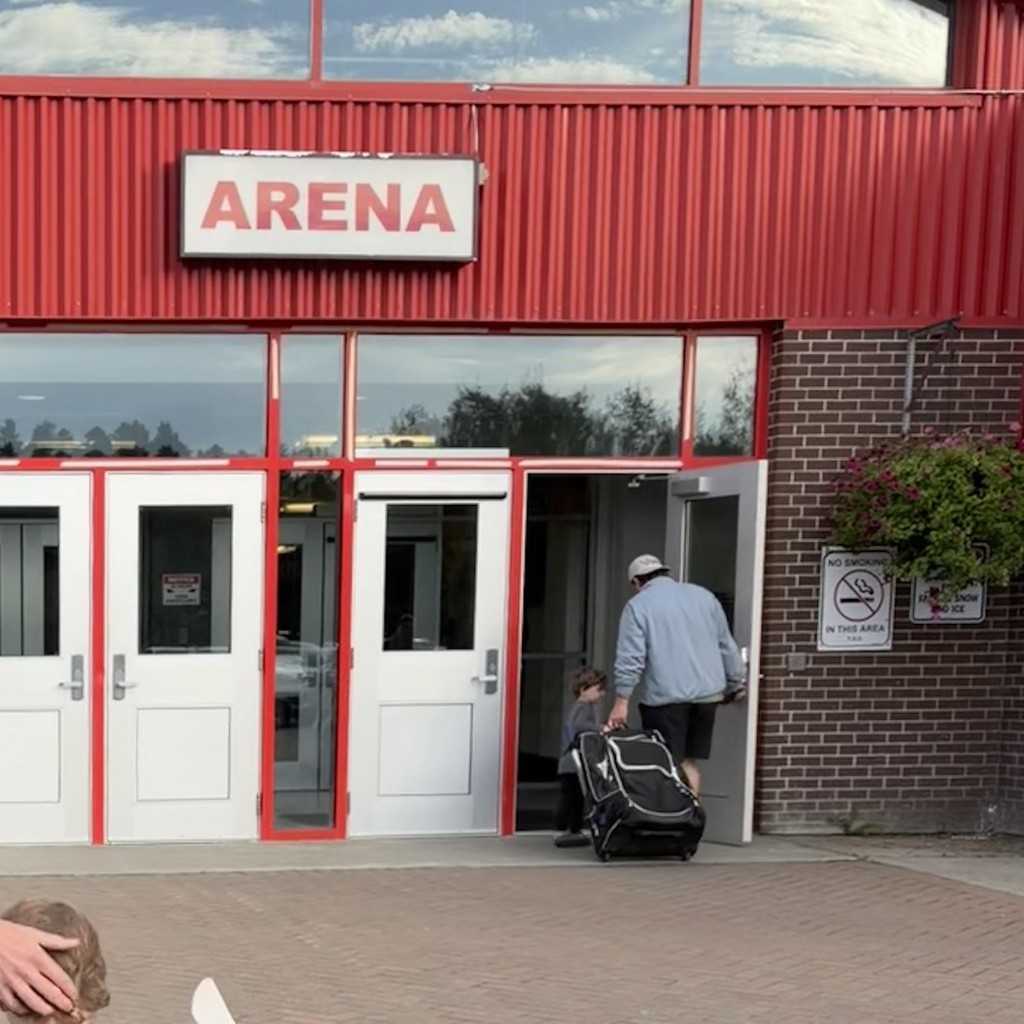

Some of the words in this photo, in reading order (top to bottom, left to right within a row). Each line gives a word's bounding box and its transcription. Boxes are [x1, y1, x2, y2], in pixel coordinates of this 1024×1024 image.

[200, 180, 456, 233] ARENA
[828, 558, 843, 568] NO
[955, 594, 979, 602] SNOW
[951, 604, 966, 613] ICE
[825, 625, 835, 634] IN
[837, 624, 858, 634] THIS
[859, 624, 885, 634] AREA
